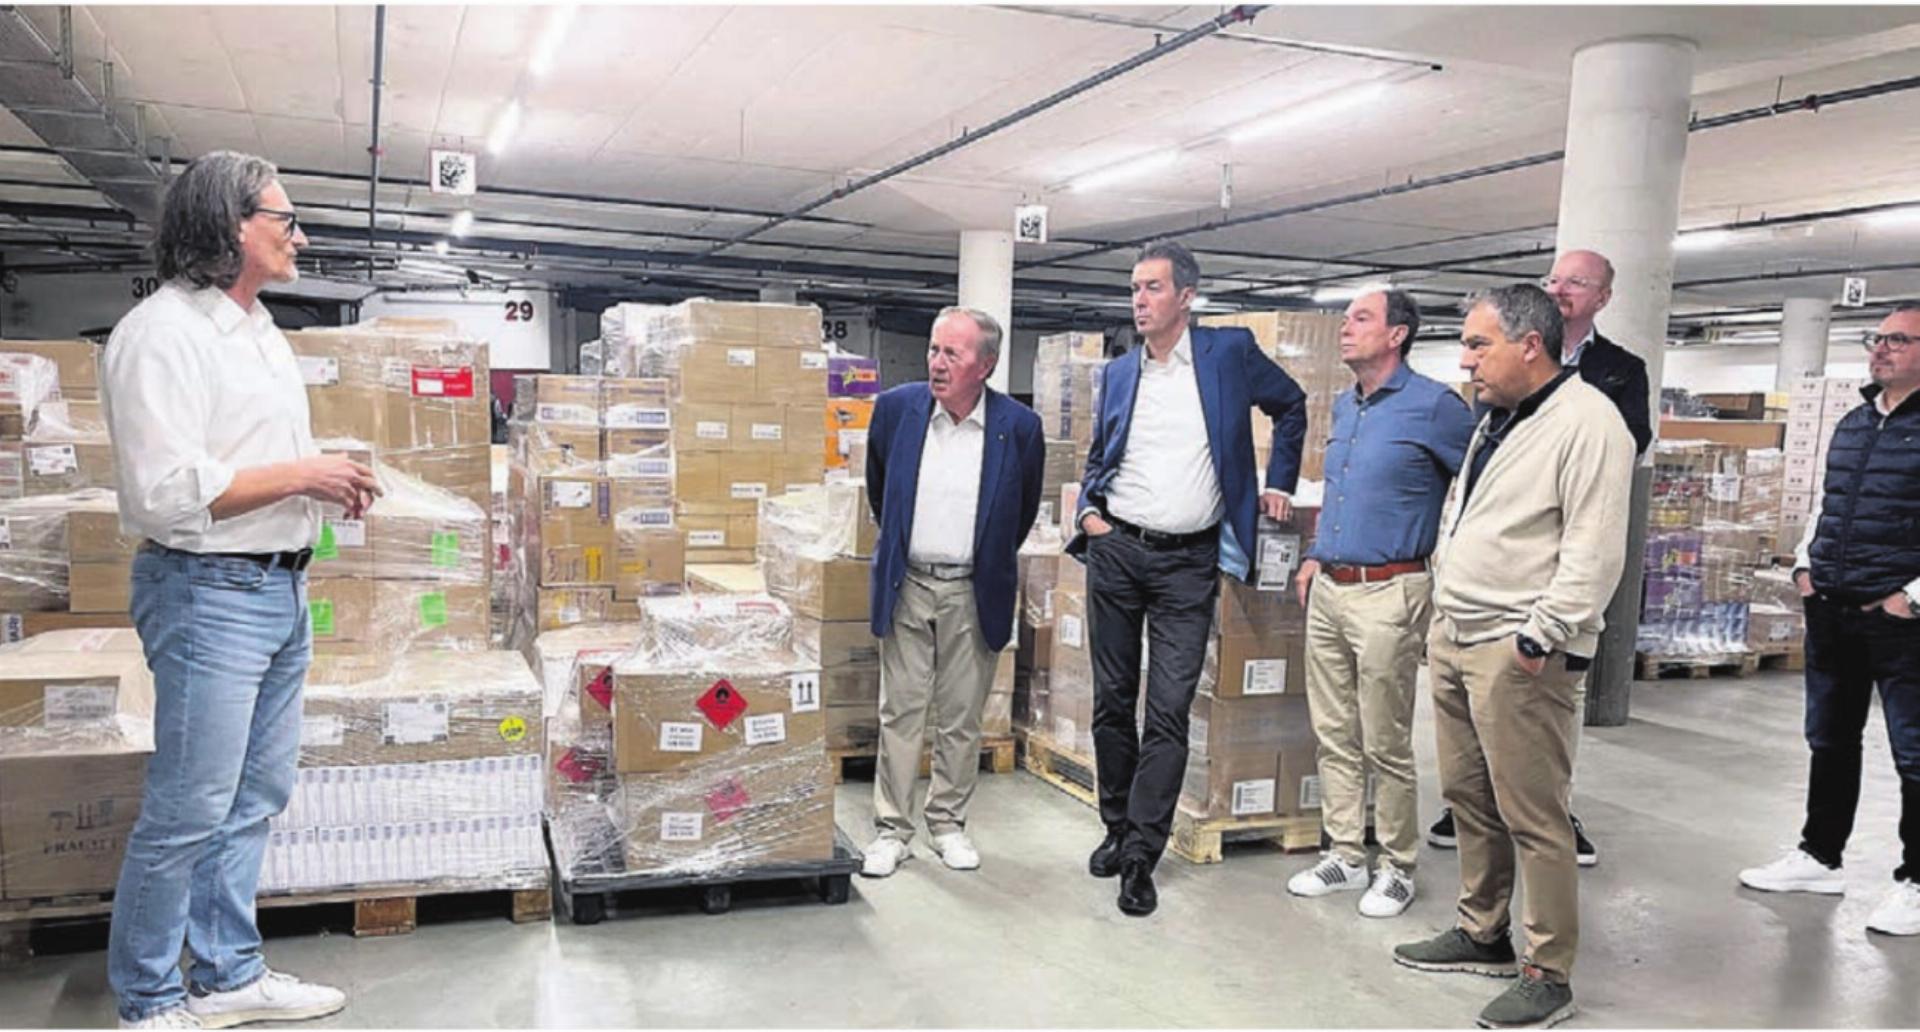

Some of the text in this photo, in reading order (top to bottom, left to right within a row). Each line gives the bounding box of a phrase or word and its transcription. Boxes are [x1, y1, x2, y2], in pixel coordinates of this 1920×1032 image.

[132, 276, 159, 299] 30
[505, 300, 533, 321] 29
[822, 320, 848, 339] 28
